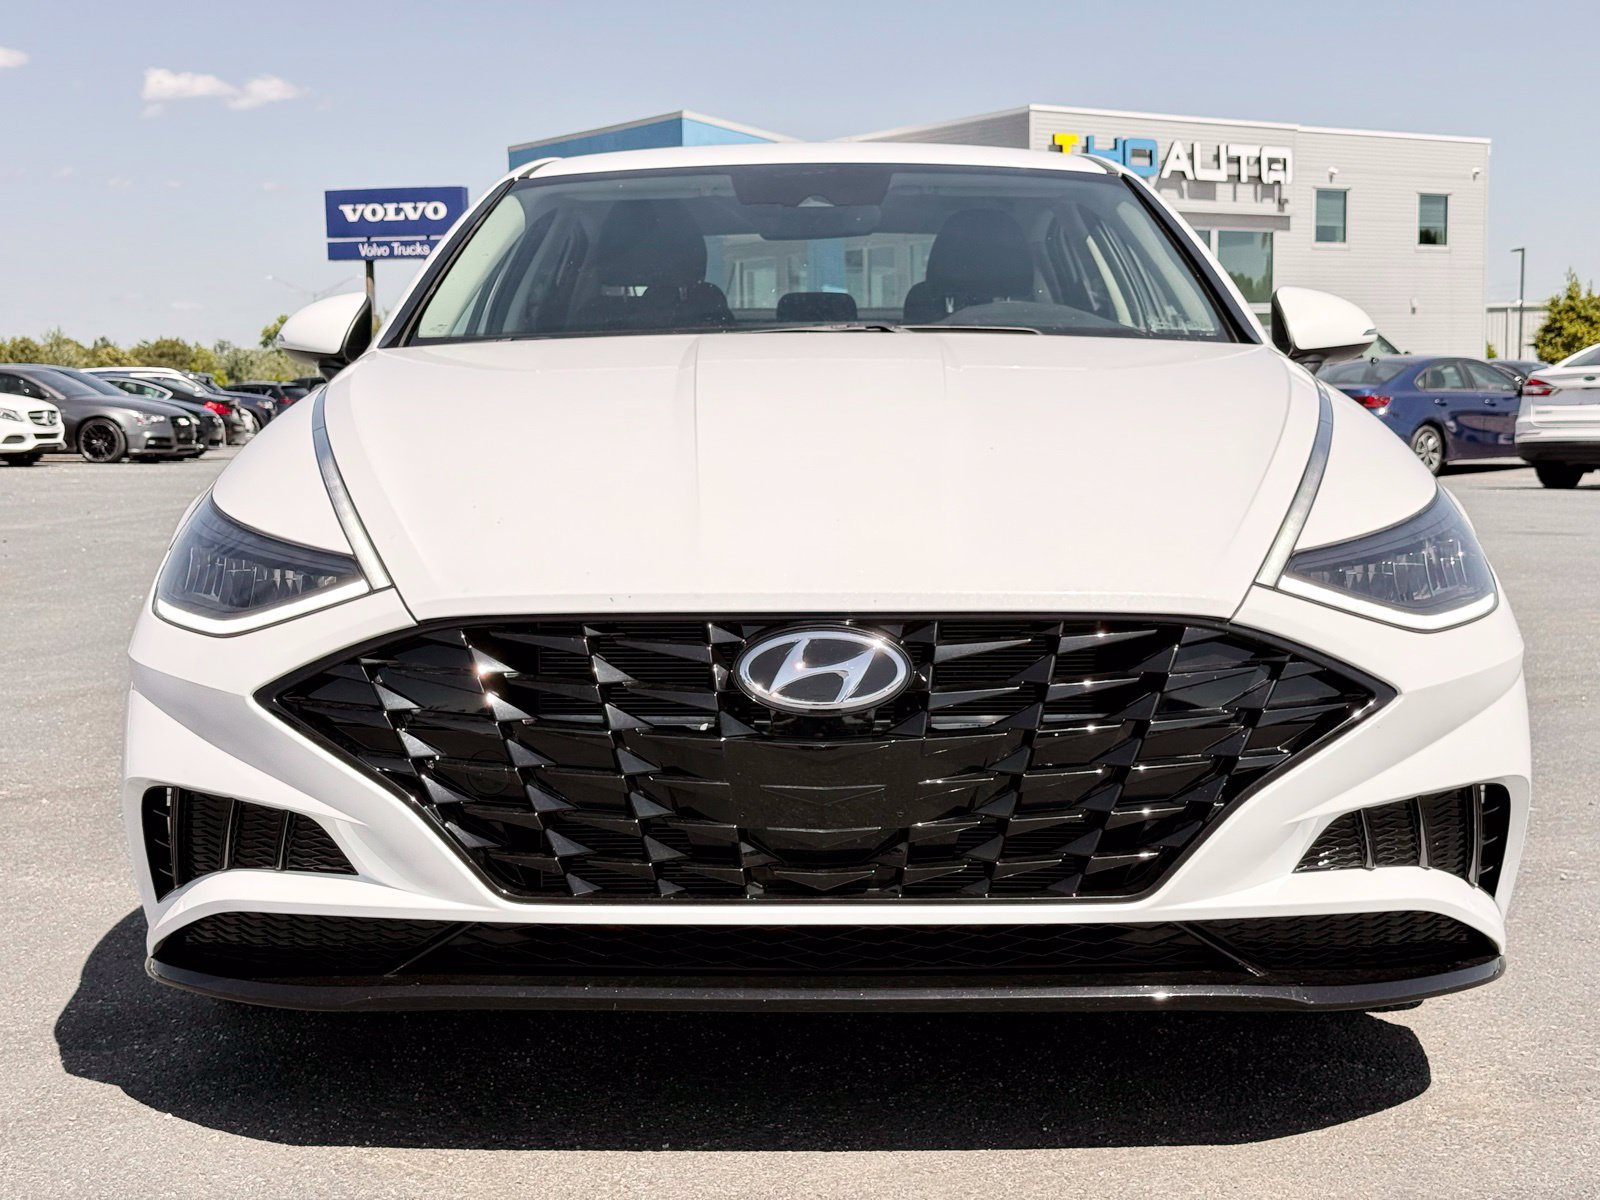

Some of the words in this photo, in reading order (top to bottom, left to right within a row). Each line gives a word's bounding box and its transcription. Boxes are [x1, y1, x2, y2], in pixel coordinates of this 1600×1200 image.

[338, 201, 448, 222] VOLVO
[358, 242, 390, 257] Volvo
[391, 241, 430, 256] Trucks
